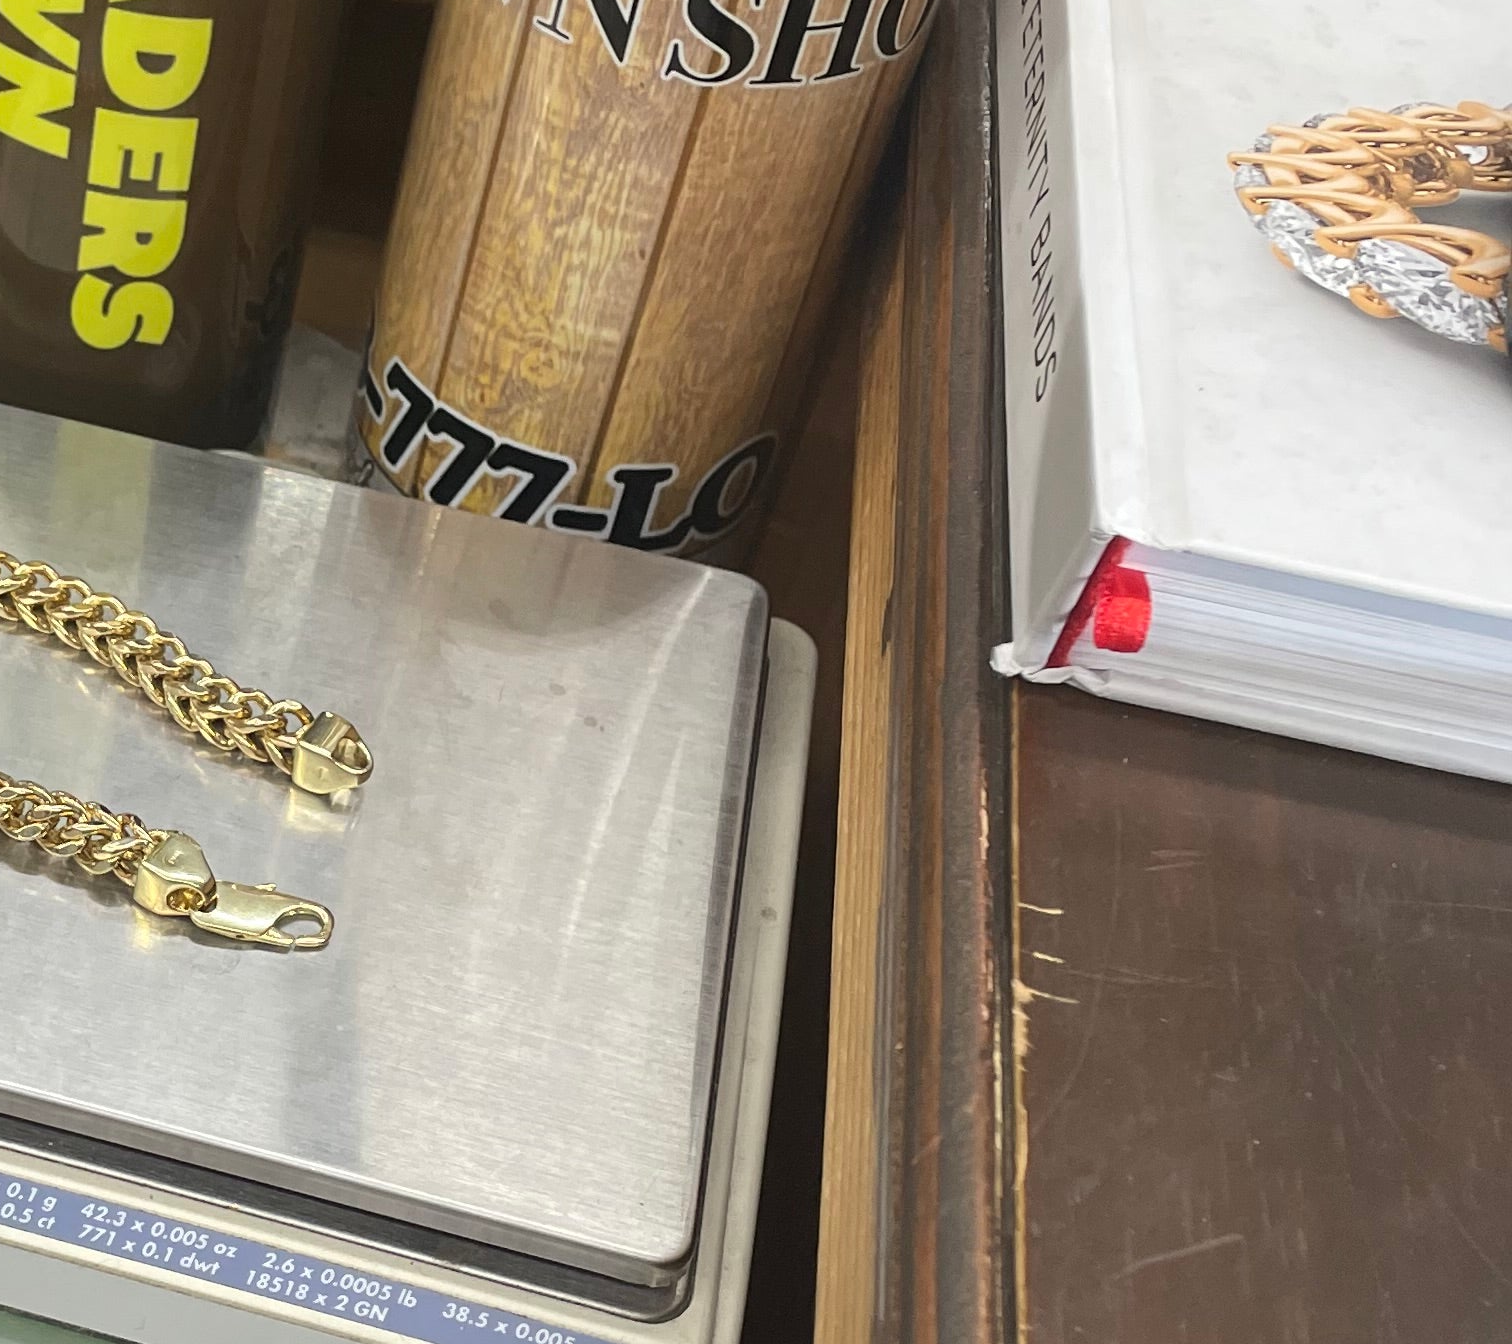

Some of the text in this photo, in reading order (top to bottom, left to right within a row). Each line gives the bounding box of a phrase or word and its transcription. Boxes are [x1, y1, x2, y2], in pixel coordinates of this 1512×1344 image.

[1030, 212, 1057, 402] BANDS
[0, 1203, 32, 1224] 0.5
[37, 1214, 56, 1230] ct
[78, 1224, 117, 1246] 771
[121, 1239, 137, 1253] x
[141, 1241, 173, 1262] 0.1
[180, 1251, 221, 1276] dwt
[245, 1270, 309, 1300] 18518
[313, 1292, 328, 1306] x
[334, 1294, 349, 1311] 2
[354, 1300, 390, 1322] GN
[7, 1182, 38, 1202] 0.1
[42, 1196, 57, 1212] g
[80, 1203, 126, 1229] 42.3
[131, 1220, 145, 1233] x
[150, 1222, 208, 1249] 0.005
[213, 1241, 238, 1258] oz
[261, 1252, 295, 1275] 2.6
[300, 1266, 315, 1279] x
[320, 1268, 392, 1301] 0.0005
[397, 1288, 418, 1308] lb
[442, 1303, 489, 1329] 38.5
[494, 1320, 510, 1334] x
